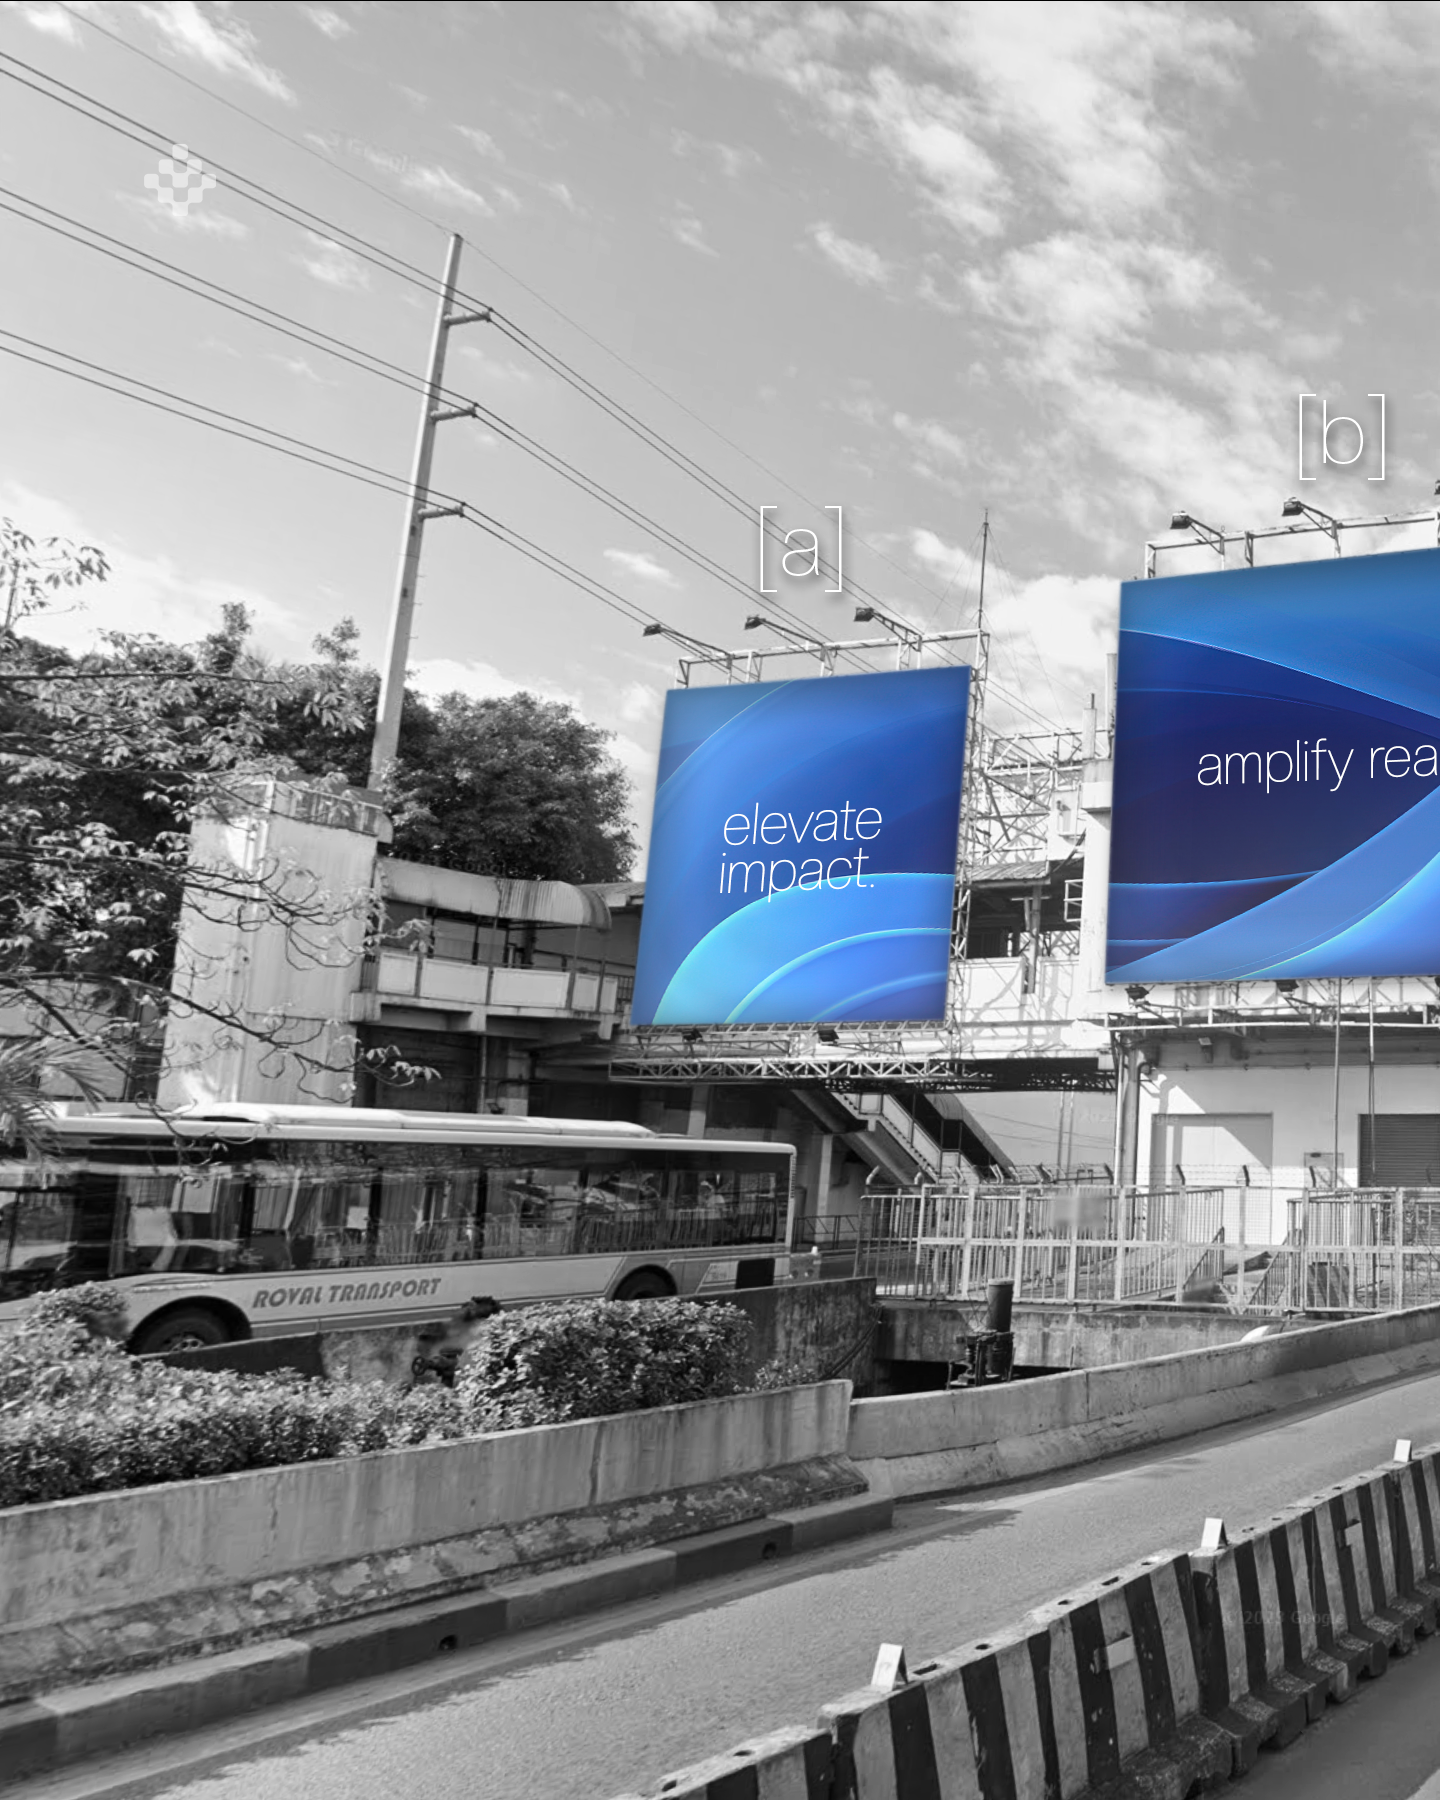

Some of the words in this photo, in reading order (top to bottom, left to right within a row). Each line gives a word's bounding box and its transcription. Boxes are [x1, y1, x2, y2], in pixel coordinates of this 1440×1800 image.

[1197, 738, 1354, 794] amplify
[723, 800, 882, 846] elevate
[719, 847, 876, 903] impact.
[252, 1287, 323, 1308] ROYAL
[327, 1278, 441, 1303] TRANSPORT
